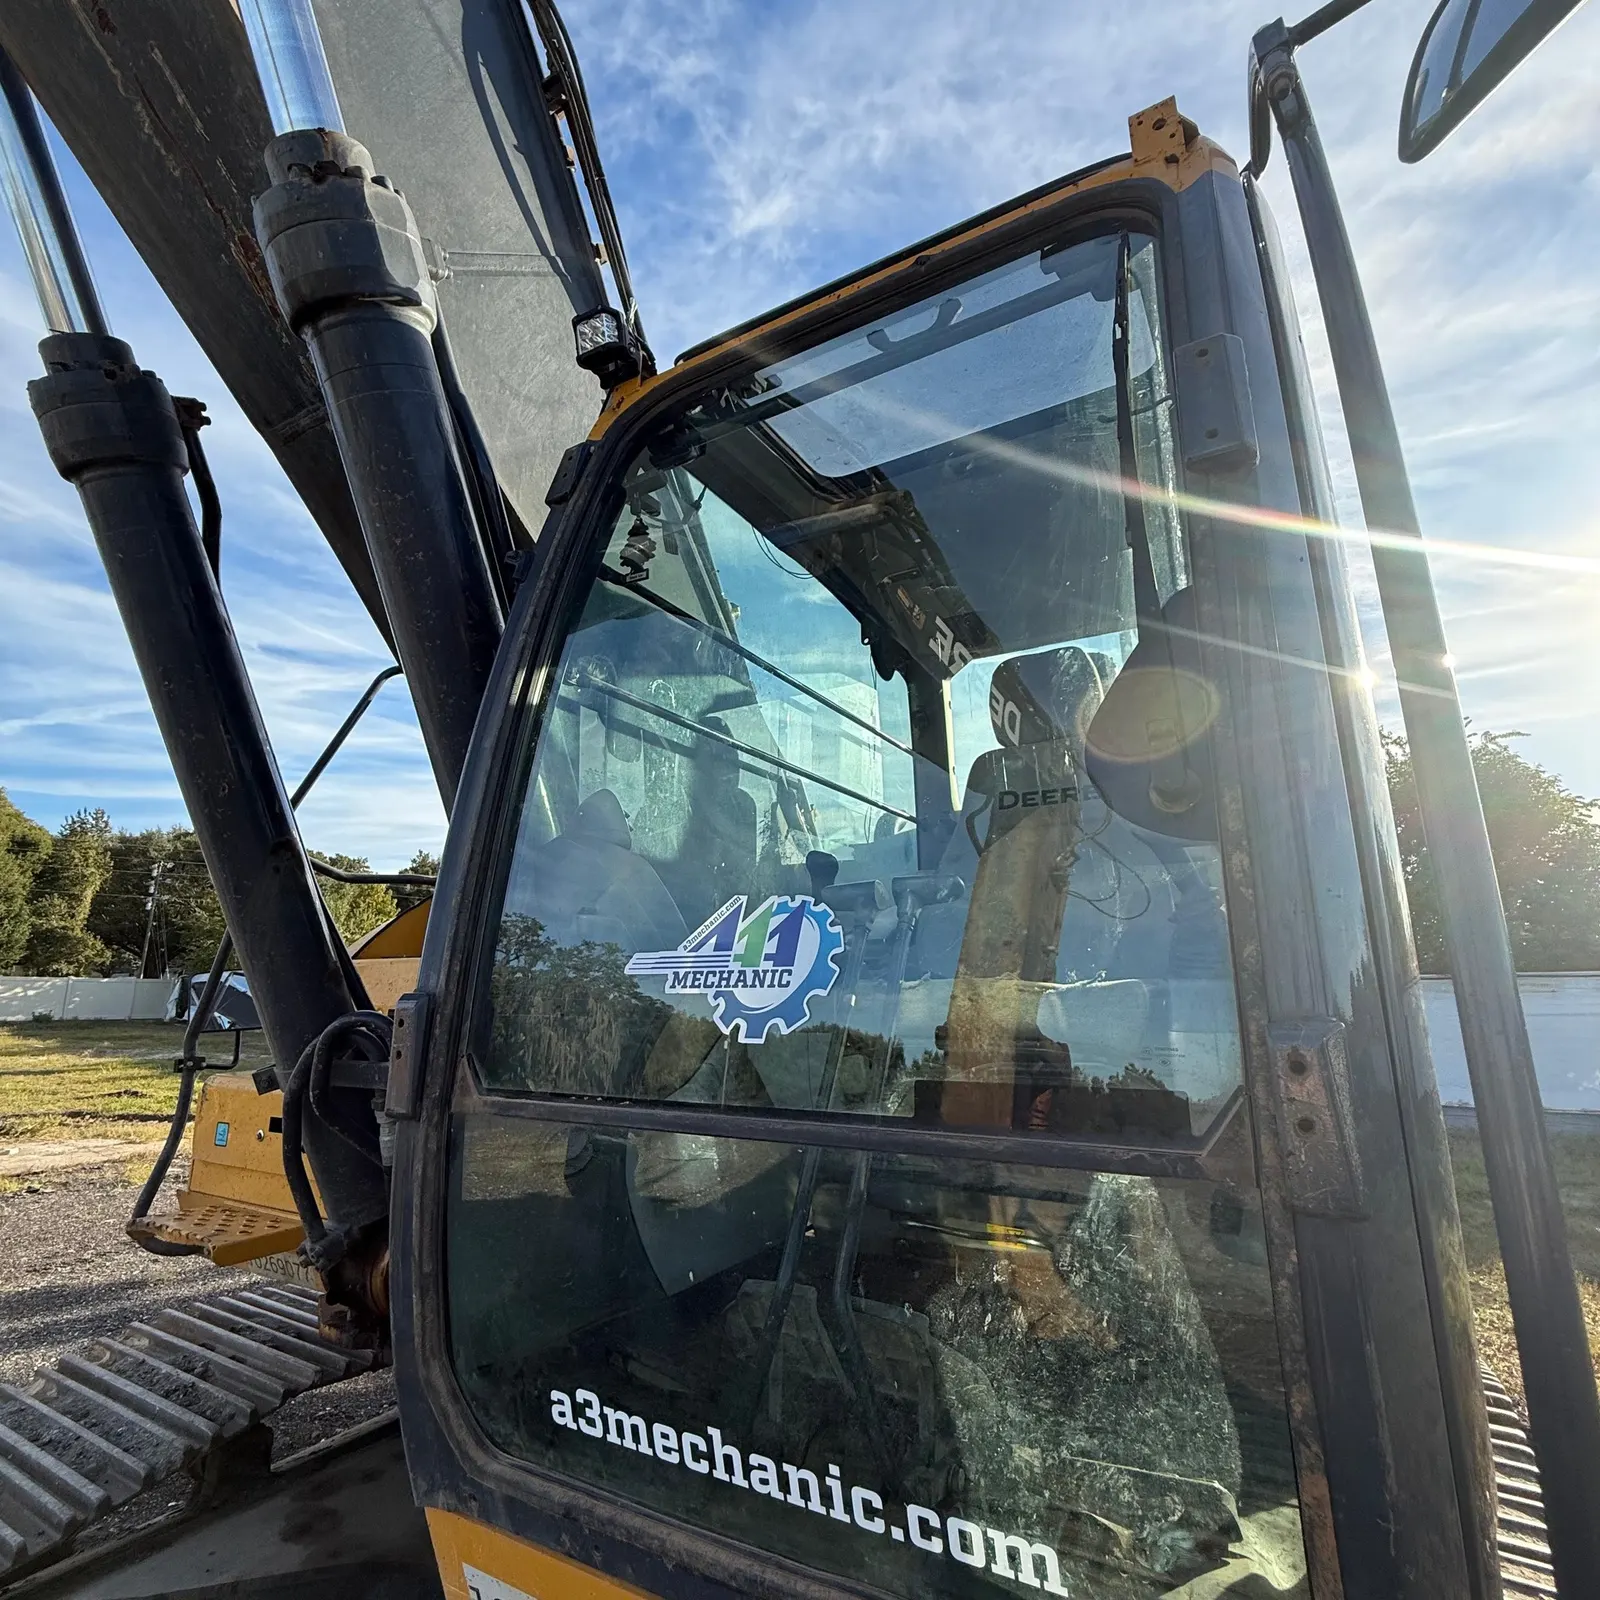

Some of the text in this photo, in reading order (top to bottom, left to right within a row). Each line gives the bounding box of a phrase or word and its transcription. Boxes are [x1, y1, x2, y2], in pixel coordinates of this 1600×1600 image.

[682, 895, 742, 952] a3mechanic.com
[669, 968, 793, 989] MECHANIC
[549, 1388, 1069, 1597] a3mechanic.com
